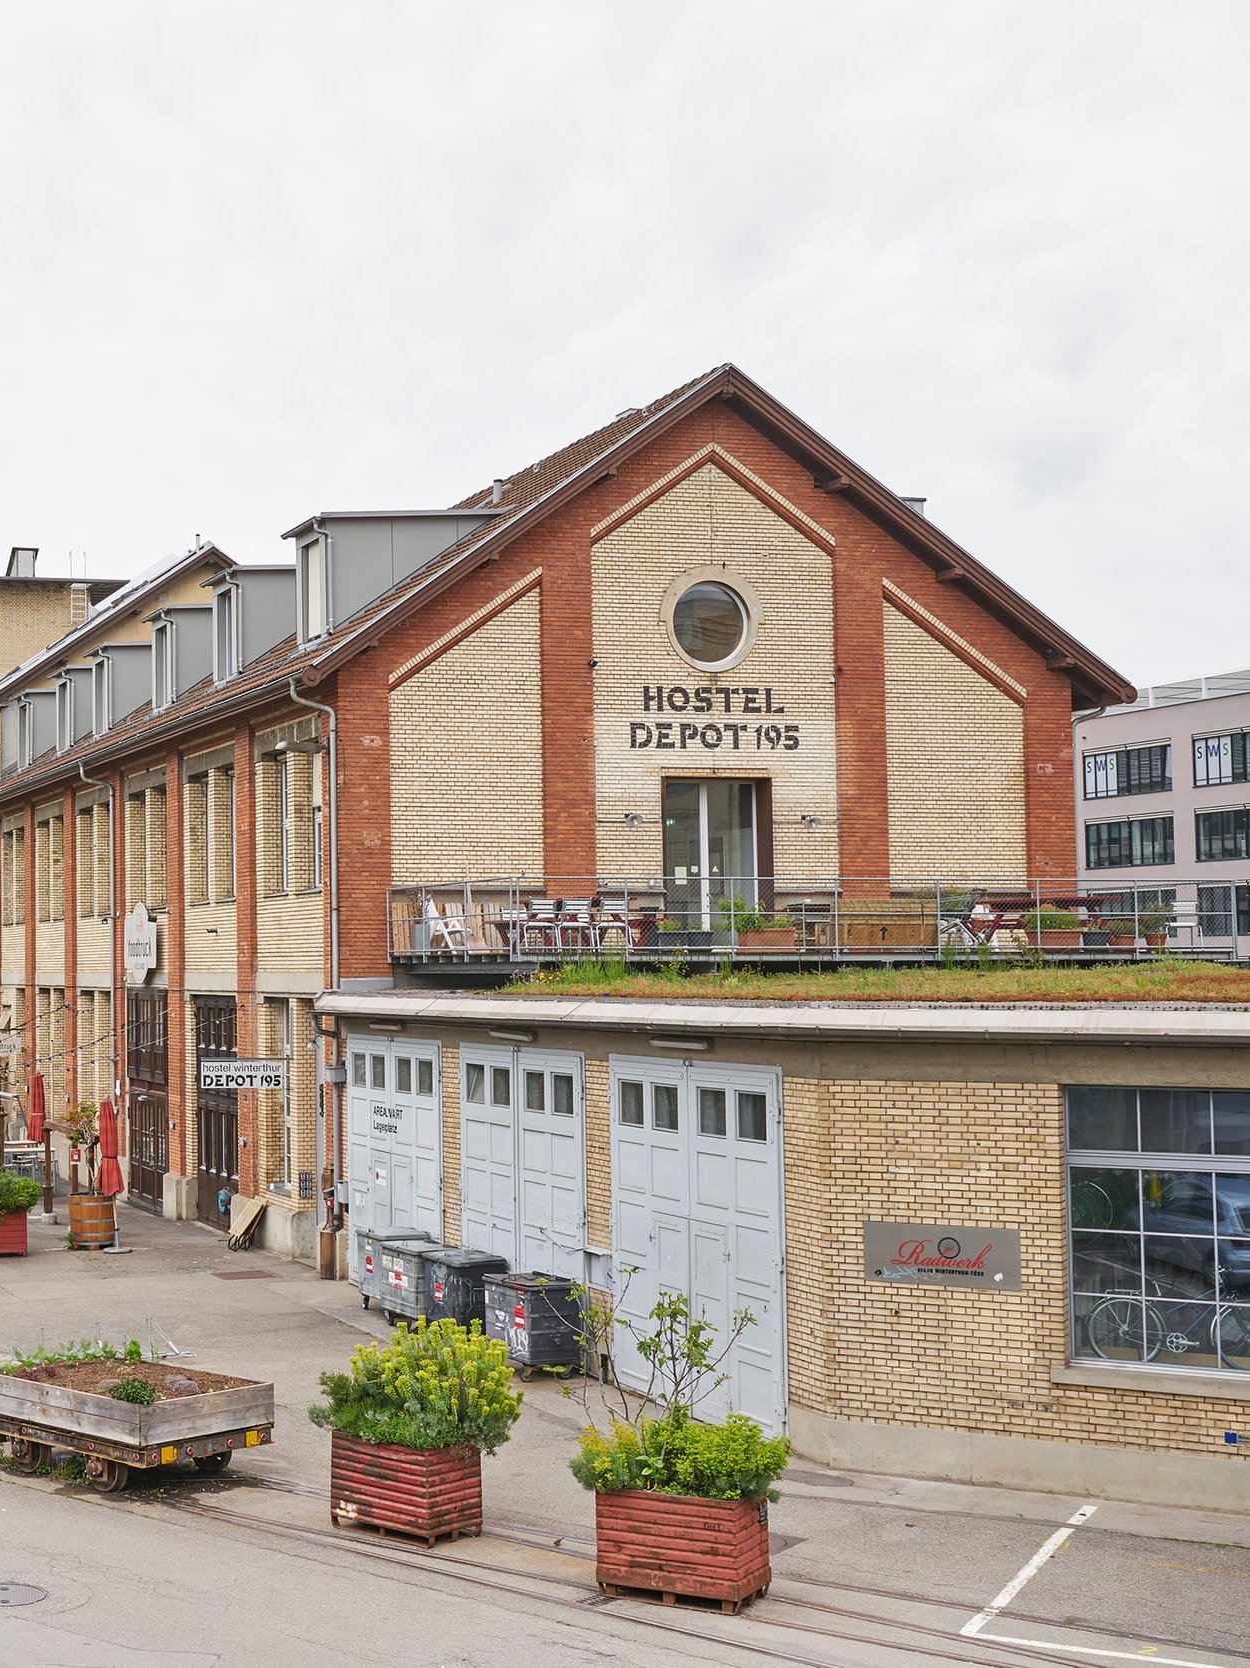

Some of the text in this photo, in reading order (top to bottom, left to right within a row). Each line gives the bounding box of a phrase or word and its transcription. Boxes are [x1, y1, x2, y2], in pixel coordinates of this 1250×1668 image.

[643, 685, 785, 713] HOSTEL
[629, 722, 800, 751] DEPOT 195
[202, 1063, 281, 1073] hostel winterthur
[203, 1074, 281, 1087] DEPOT 195
[890, 1239, 993, 1269] Radwerk
